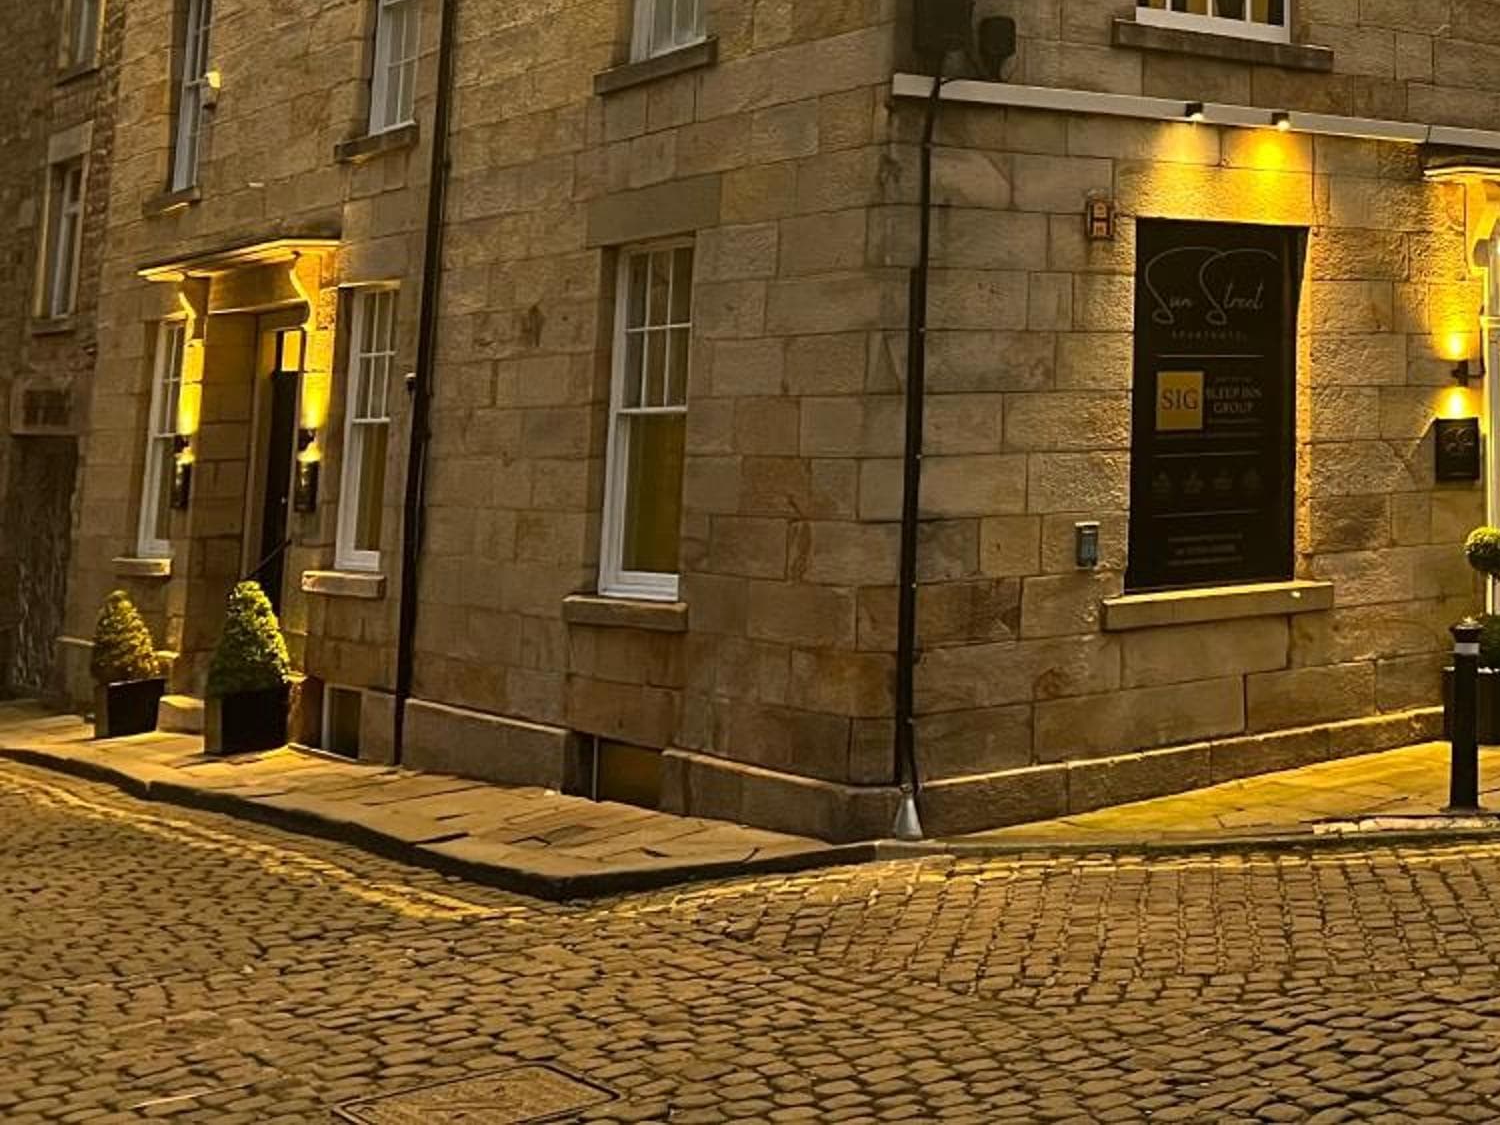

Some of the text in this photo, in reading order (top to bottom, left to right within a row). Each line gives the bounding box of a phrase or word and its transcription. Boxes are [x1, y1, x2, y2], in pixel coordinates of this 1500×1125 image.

[1145, 246, 1279, 326] Sun Street
[1161, 388, 1199, 411] SIG
